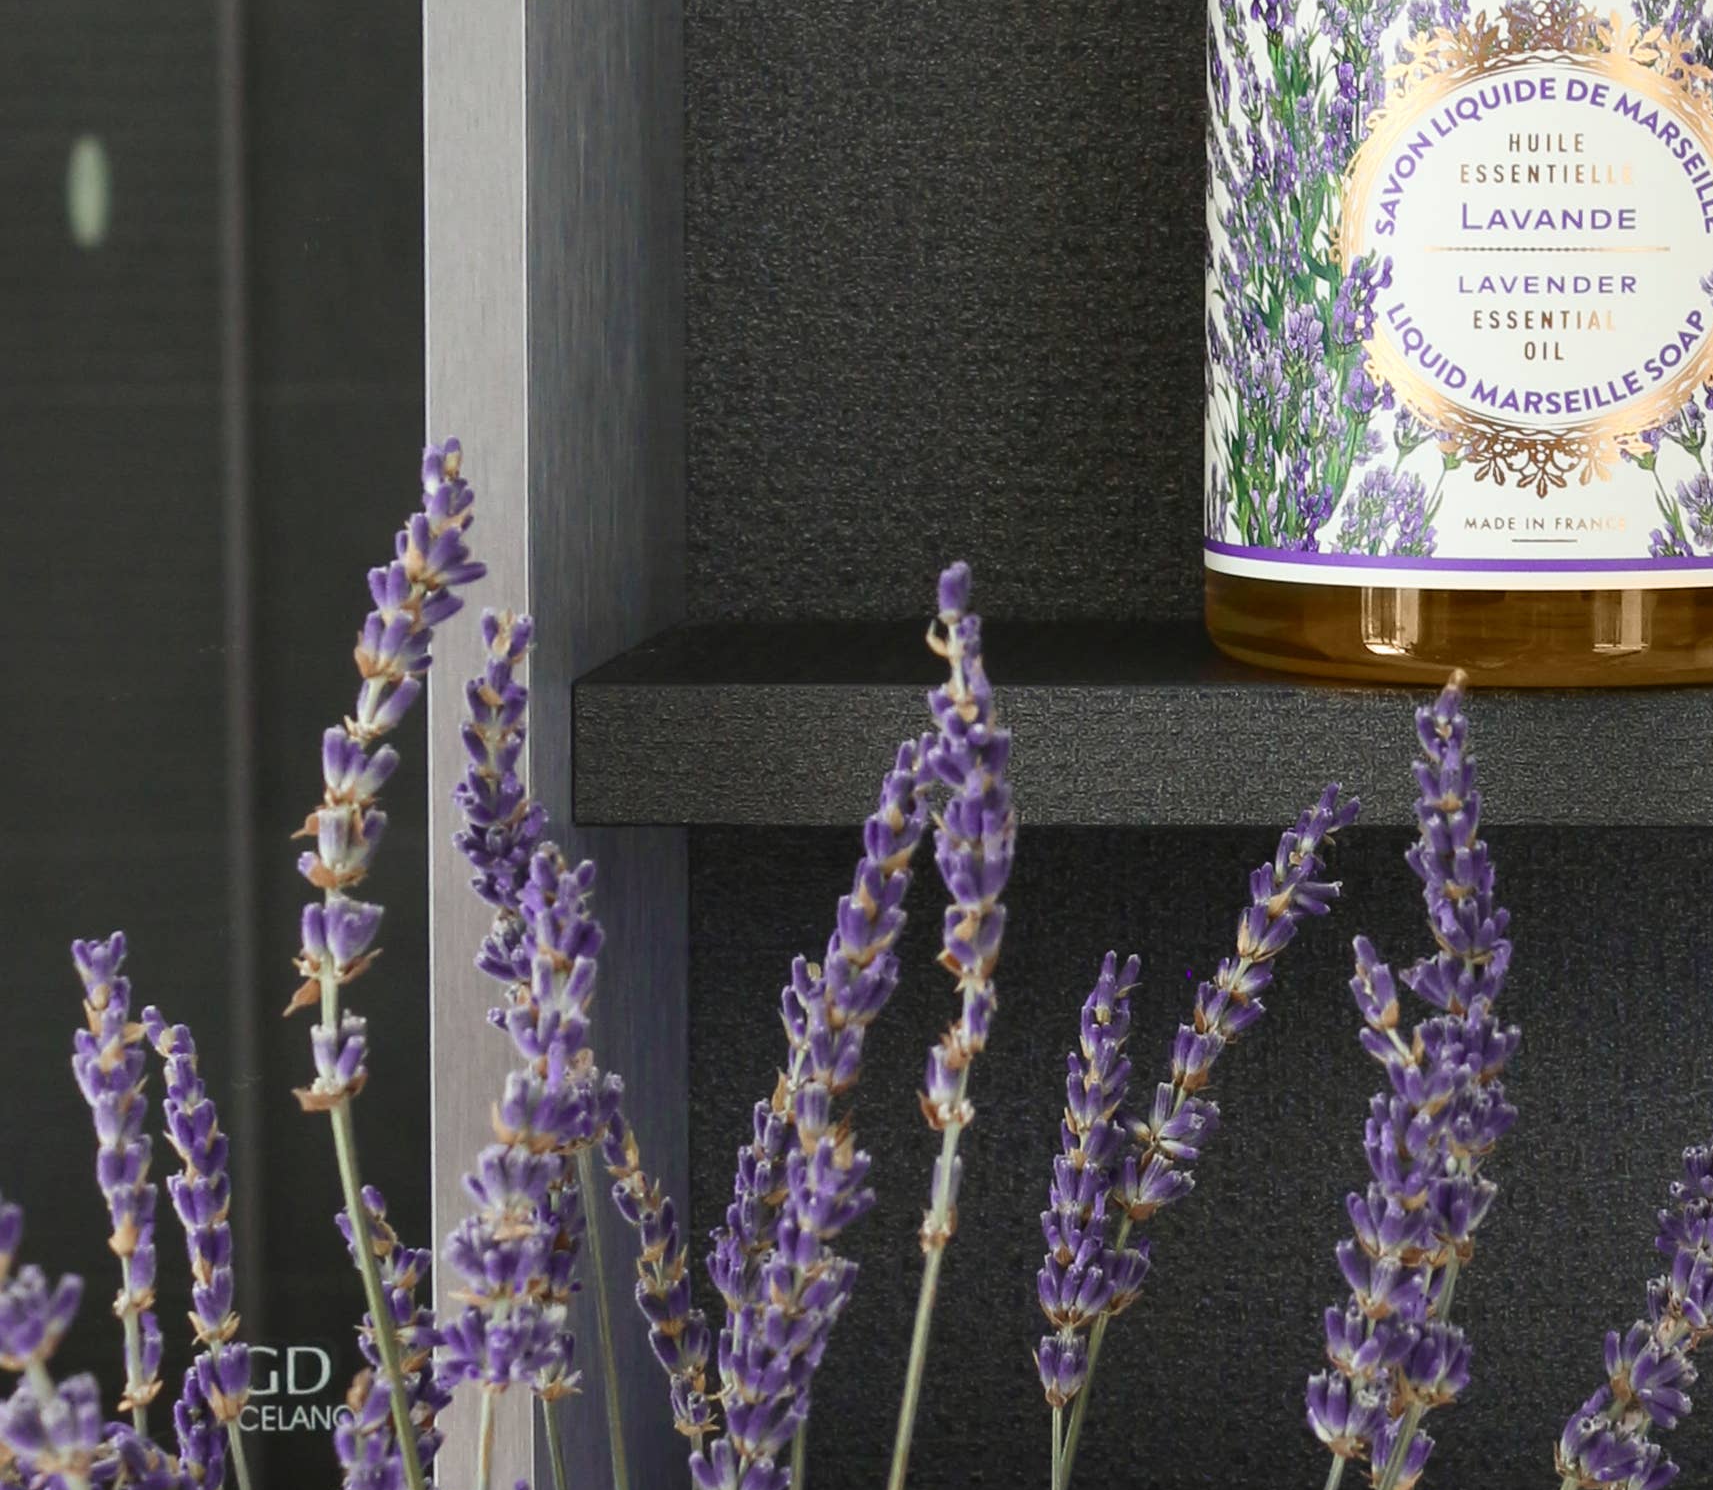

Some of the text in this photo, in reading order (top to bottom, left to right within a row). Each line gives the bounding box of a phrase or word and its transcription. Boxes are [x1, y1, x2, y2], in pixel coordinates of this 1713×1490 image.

[1509, 133, 1584, 153] HUILE
[1376, 131, 1433, 236] SAVON
[1431, 78, 1556, 137] LIQUIDE
[1566, 79, 1609, 107] DE
[1460, 164, 1633, 183] ESSENTIELLE
[1459, 275, 1637, 294] LAVENDER
[1473, 310, 1616, 329] ESSENTIAL
[1386, 303, 1708, 414] LIQUID MARSEILLE SOAP
[1524, 342, 1564, 360] OIL
[1464, 517, 1626, 531] MADE IN FRANCE
